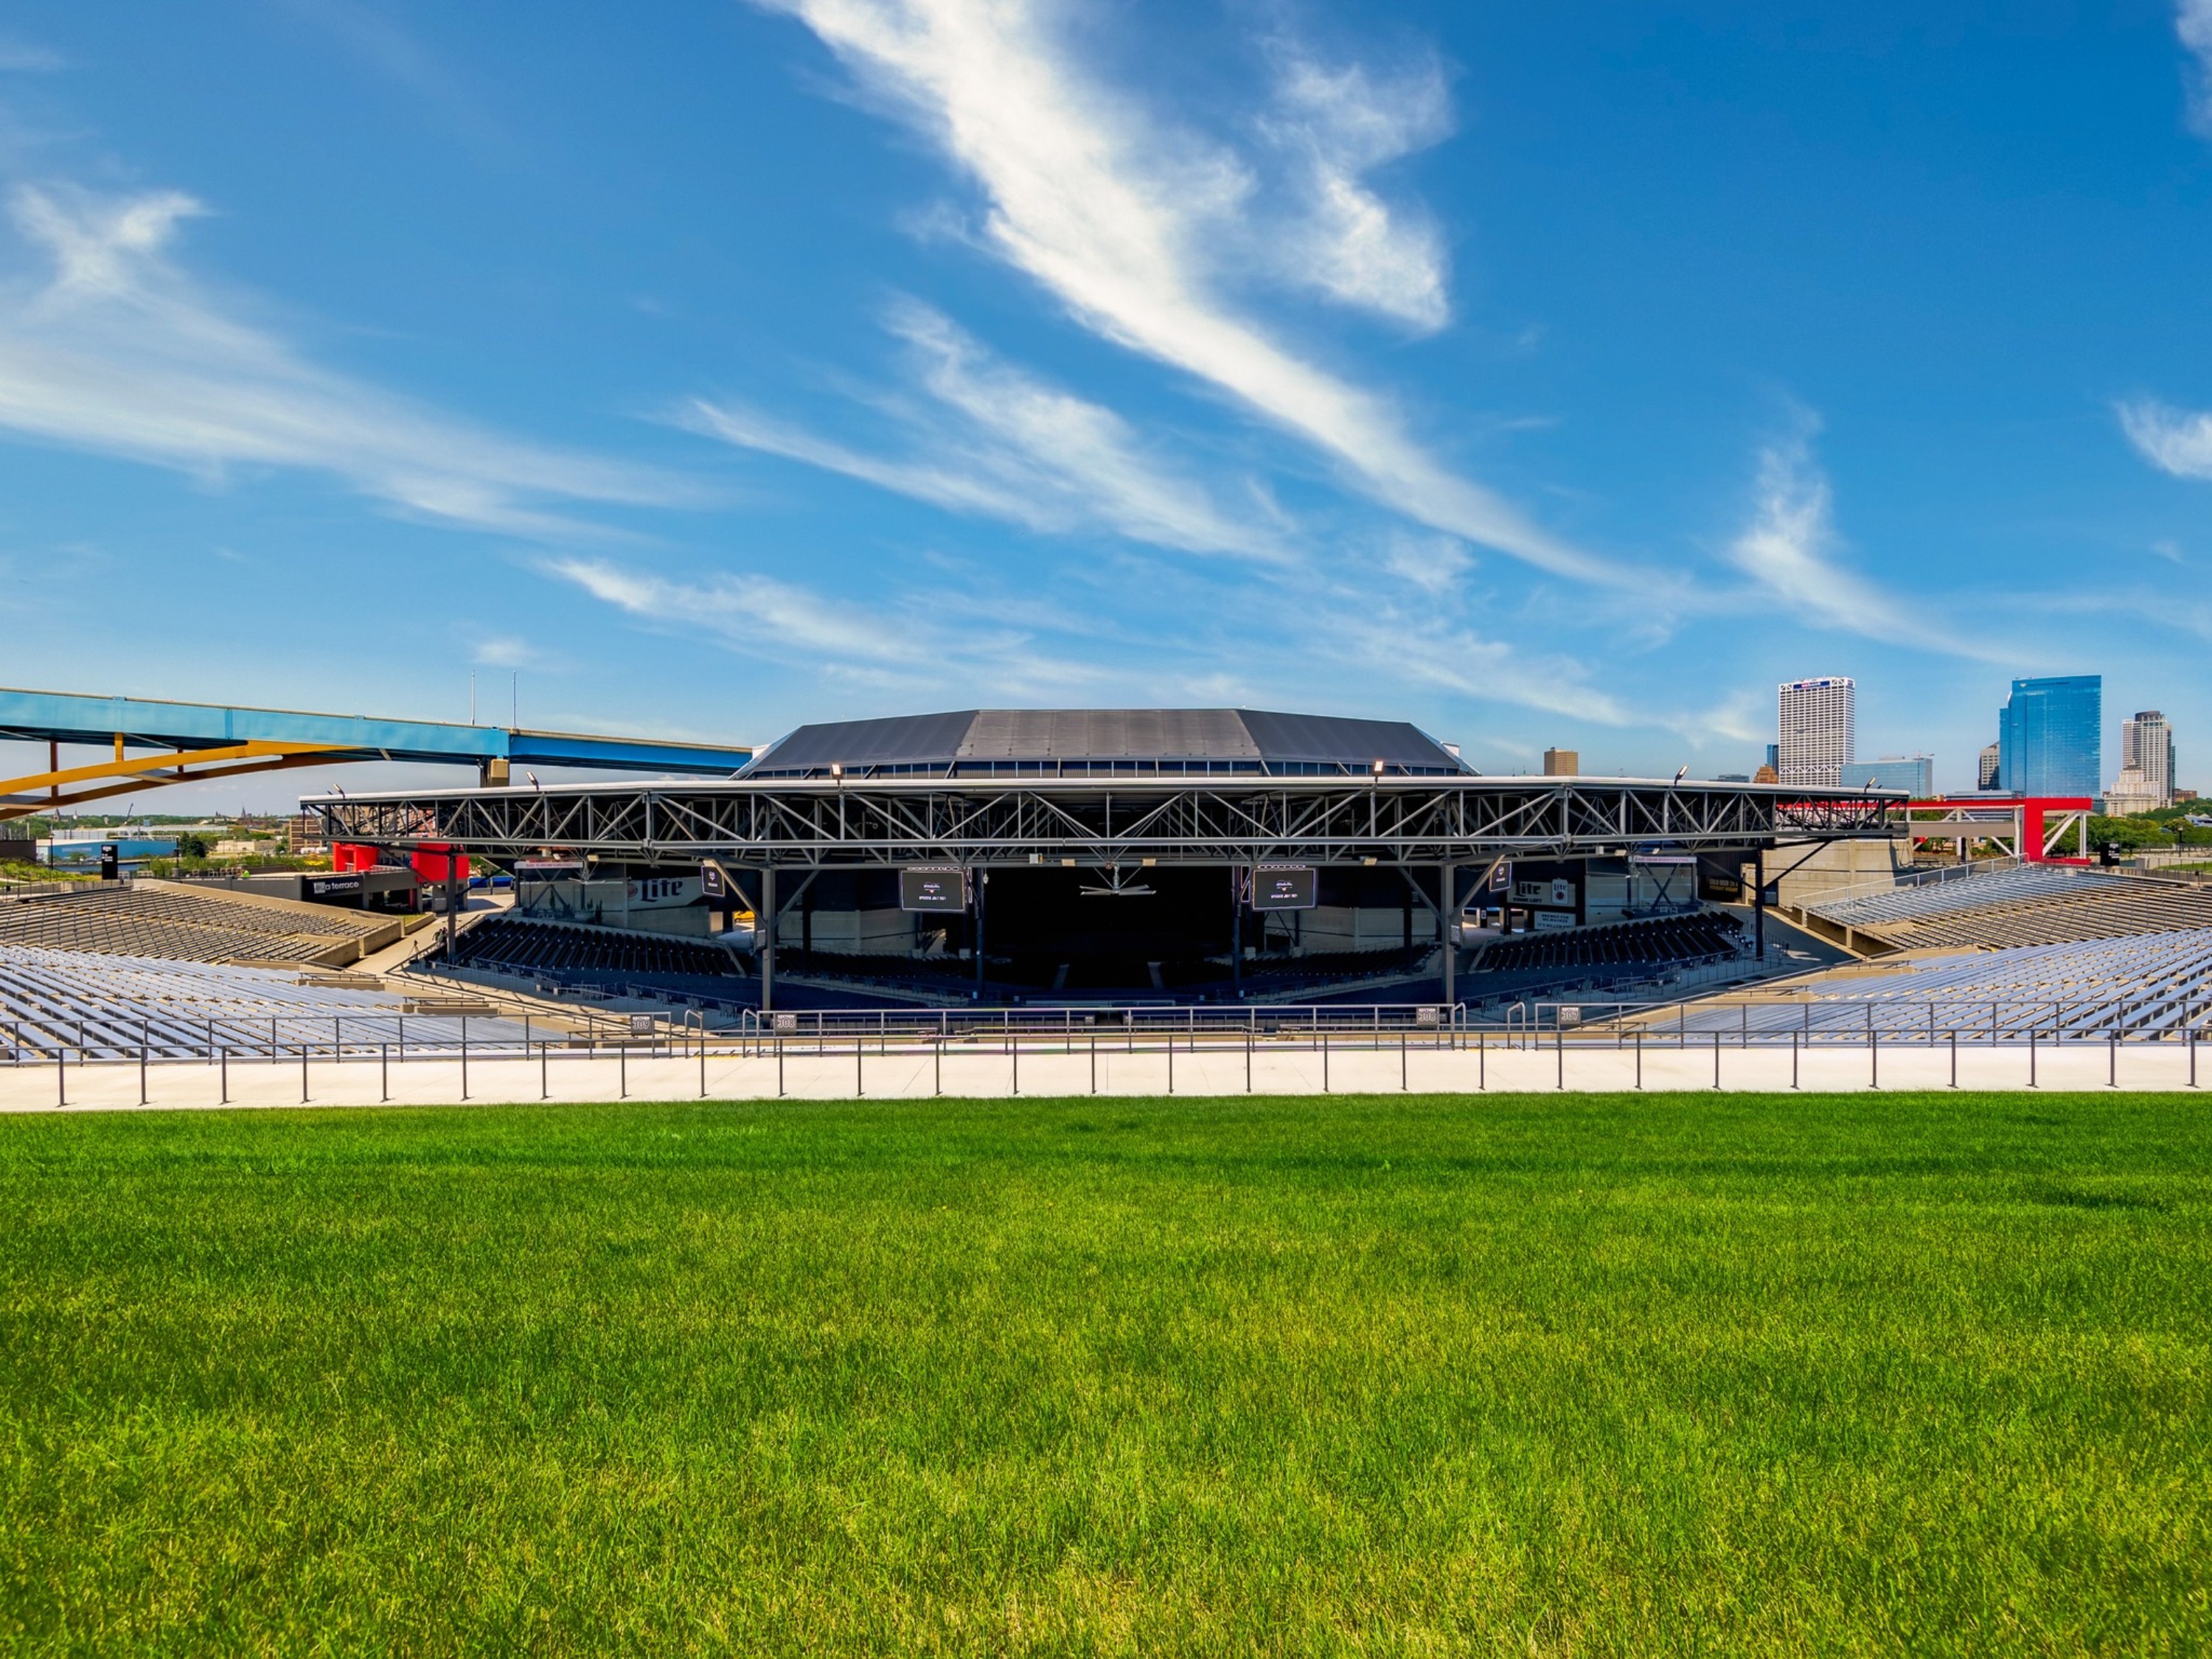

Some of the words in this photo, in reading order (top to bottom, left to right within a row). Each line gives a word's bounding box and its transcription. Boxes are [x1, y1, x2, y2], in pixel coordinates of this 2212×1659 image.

[332, 881, 359, 890] terrace
[641, 877, 684, 902] Lite
[1516, 882, 1541, 897] Lite
[1554, 883, 1568, 891] Lite
[1419, 1012, 1436, 1021] 308
[1561, 1011, 1579, 1020] 307
[633, 1020, 650, 1030] 309
[777, 1019, 796, 1028] 308
